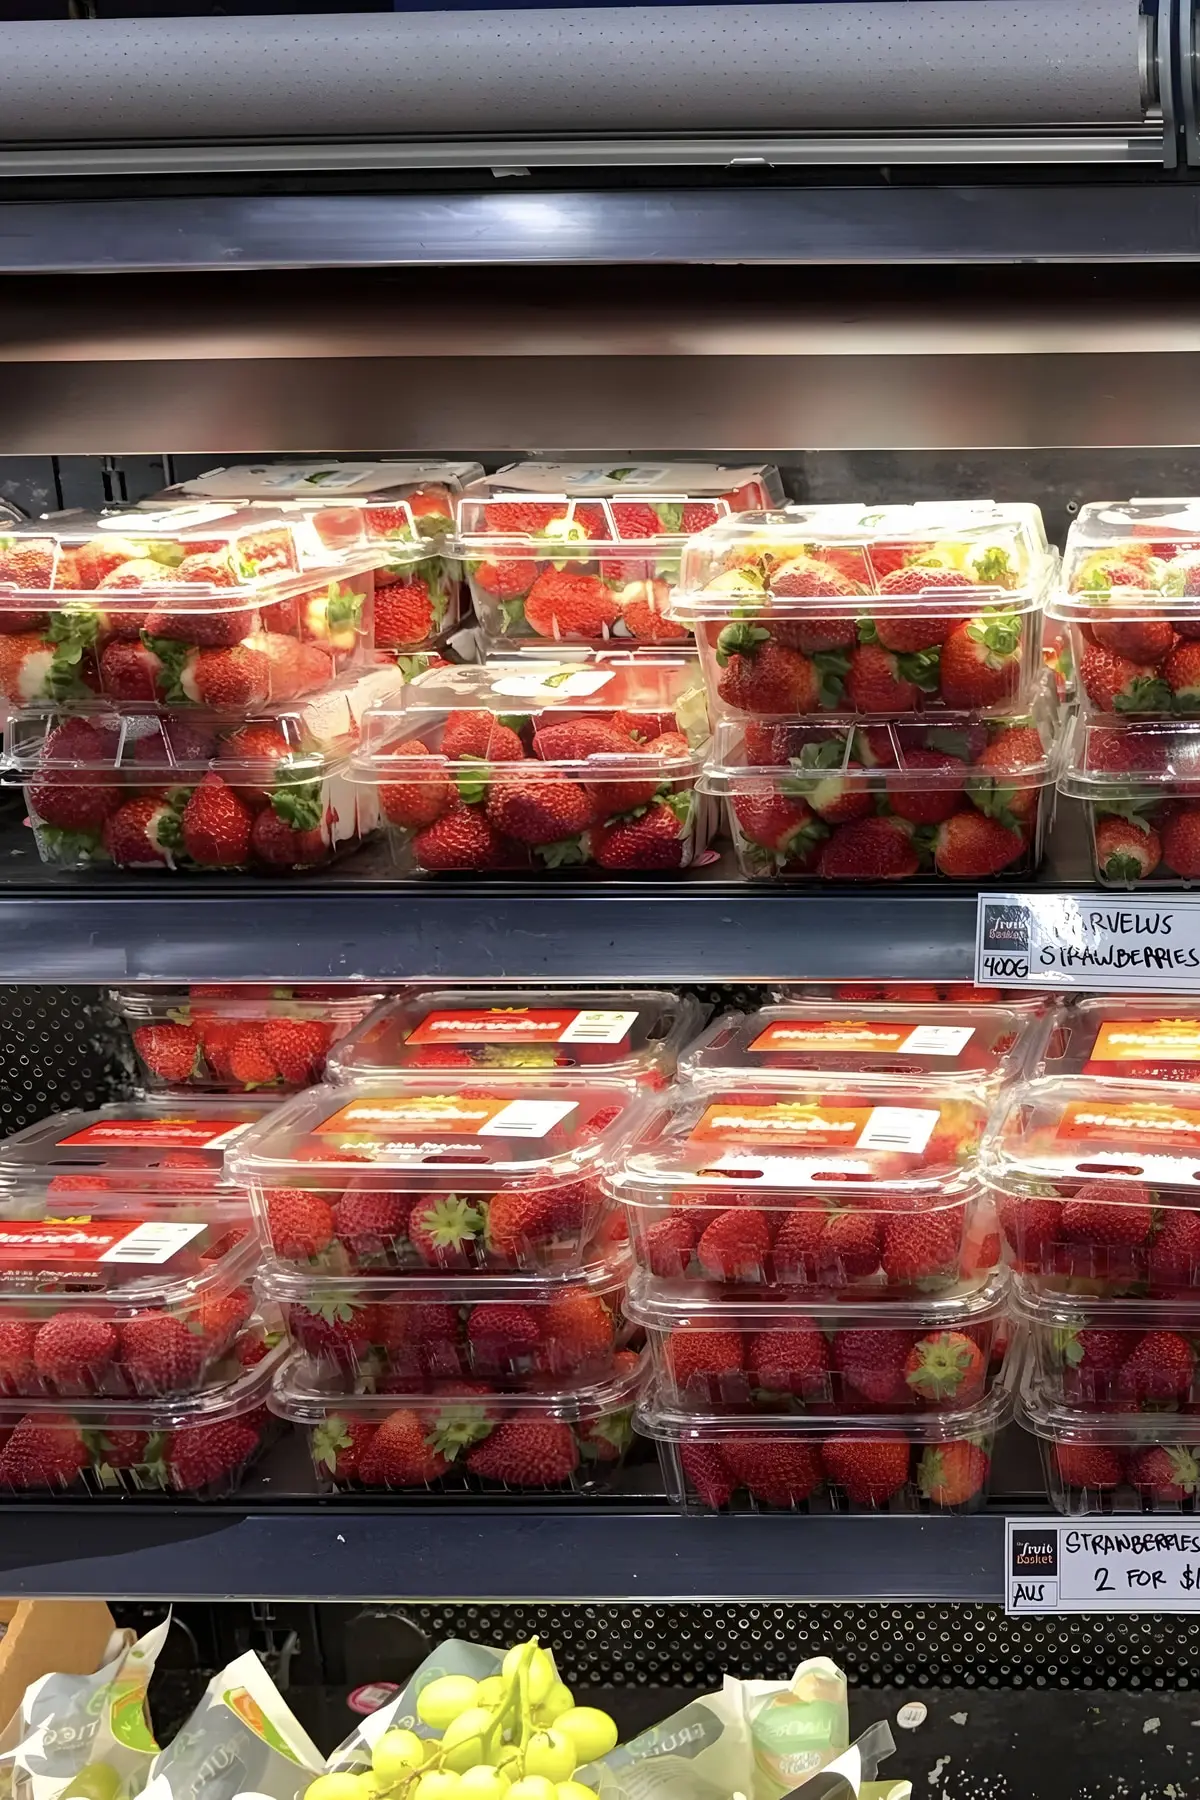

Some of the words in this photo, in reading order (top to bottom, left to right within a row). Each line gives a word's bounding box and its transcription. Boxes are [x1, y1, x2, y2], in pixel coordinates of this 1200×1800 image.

[984, 957, 1029, 978] 400G
[1020, 1542, 1053, 1556] fruit
[1065, 1531, 1200, 1554] STRAWBERRIES
[1094, 1568, 1115, 1591] 2
[1127, 1570, 1167, 1588] FOR
[1012, 1583, 1045, 1608] AUS
